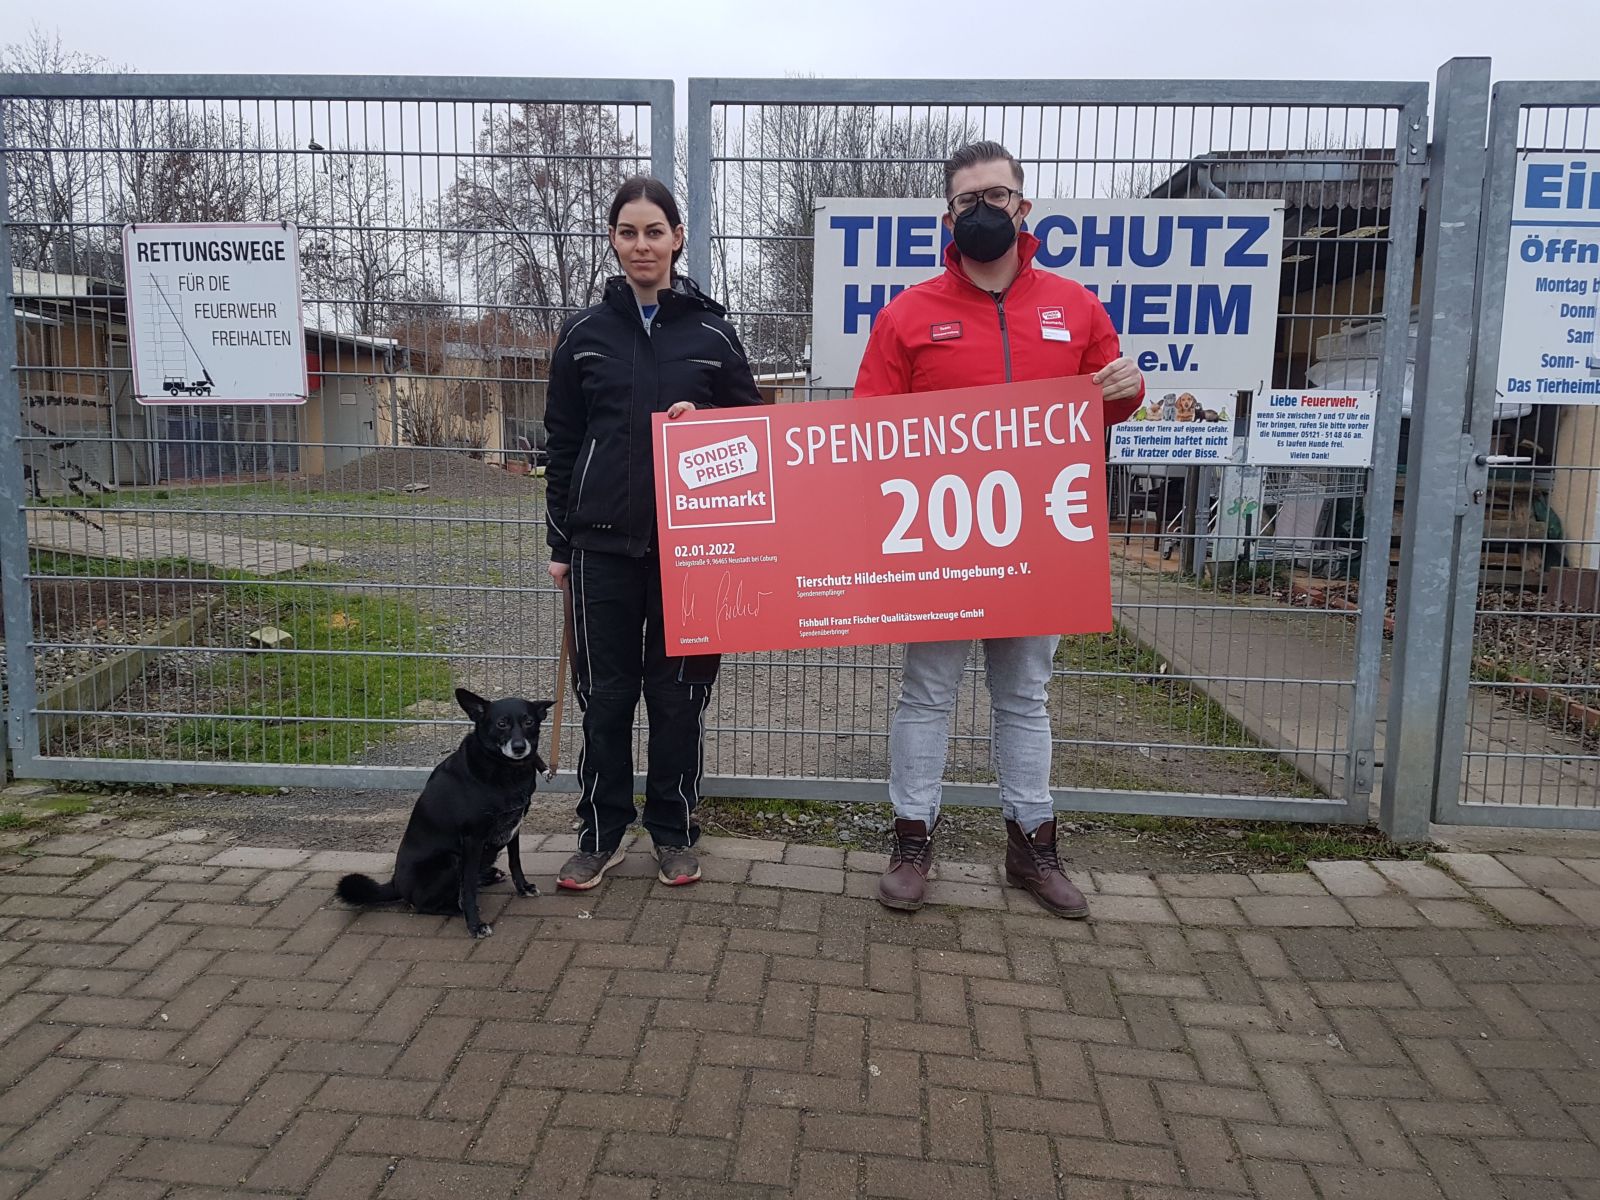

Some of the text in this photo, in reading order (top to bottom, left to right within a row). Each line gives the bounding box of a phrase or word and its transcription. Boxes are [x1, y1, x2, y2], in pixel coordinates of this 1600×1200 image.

[829, 215, 1271, 268] TIECHUTZ
[137, 240, 286, 263] RETTUNGSWEGE
[178, 272, 231, 292] FÜR DIE
[1535, 277, 1588, 295] Montag
[194, 302, 277, 319] FEUERWEHR
[212, 330, 292, 346] FREIHALTEN
[1137, 343, 1199, 372] e.V.
[1540, 353, 1580, 369] Sonn-
[1507, 377, 1532, 393] Das
[1270, 395, 1359, 409] Liebe Feuerwehr,
[1275, 411, 1286, 419] Sie
[1287, 411, 1316, 419] zwischen
[1317, 412, 1322, 420] 7
[1323, 412, 1336, 420] und
[1338, 412, 1345, 420] 17
[785, 400, 1091, 467] SPENDENSCHECK
[1116, 425, 1229, 434] Anfassen der Tiere auf eigene Gefahr.
[1256, 421, 1269, 429] Tier
[1270, 421, 1297, 430] bringen,
[1347, 422, 1369, 430] vorher
[1115, 435, 1228, 446] Das Tierheim haftet nicht
[683, 441, 748, 469] SONDER
[1121, 447, 1220, 459] für Kratzer oder Bisse.
[1311, 452, 1330, 460] Dank!
[695, 458, 745, 482] PREIS!
[675, 489, 767, 511] Baumarkt
[880, 463, 1095, 555] 200 €
[674, 542, 736, 558] 02.01.2022
[675, 558, 706, 568] Liebigstraße
[728, 556, 751, 564] Neustadt
[751, 555, 760, 563] bei
[760, 555, 778, 563] Coburg
[796, 562, 1032, 589] Tierschutz Hildesheim und Umgebung e. V.
[796, 588, 846, 599] Spendenempfänger
[798, 609, 985, 628] Fishbull Franz Fischer Qualitätswerkzeuge GmbH
[680, 636, 709, 645] Unterschrift
[799, 628, 850, 638] Spendenüberbringer
